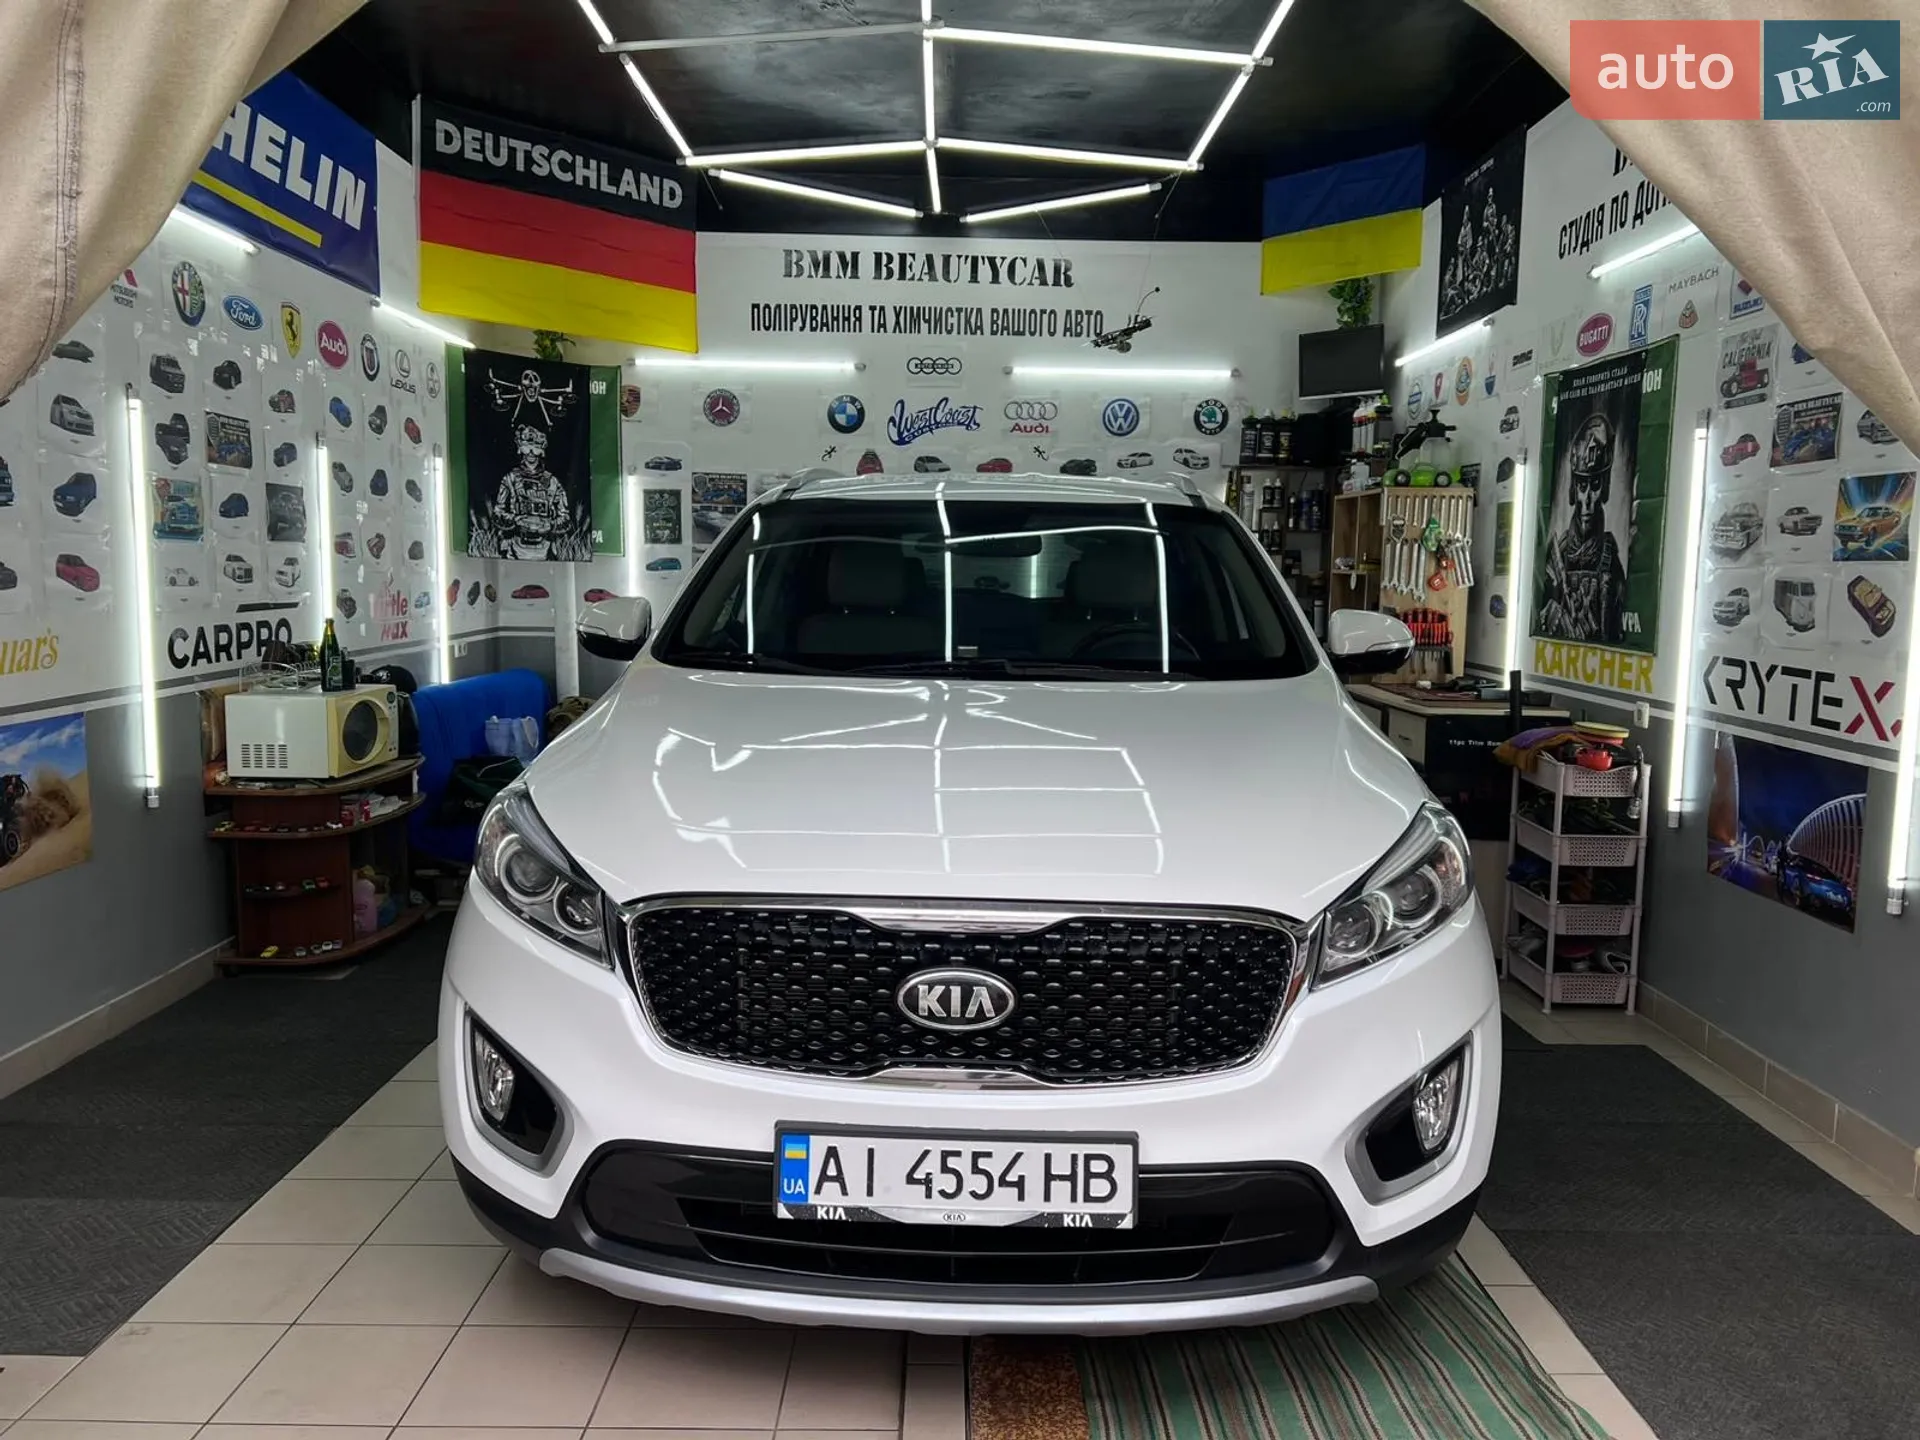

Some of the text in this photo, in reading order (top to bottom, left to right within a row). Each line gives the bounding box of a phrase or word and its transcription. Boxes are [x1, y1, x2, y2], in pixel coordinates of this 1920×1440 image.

[435, 119, 683, 209] DEUTSCHLAND
[1558, 201, 1605, 260] СТУДІЯ
[1609, 190, 1629, 234] ПО
[782, 249, 1075, 288] BMM BEAUTYCAR
[1668, 267, 1719, 294] MAYBACH
[230, 299, 257, 326] Ford
[751, 303, 1104, 338] ПОЛІРУВАННЯ ТА ХІМЧИСТКА ВАШОГО АВТО
[320, 332, 347, 356] Audi
[1579, 324, 1609, 347] BUGATTI
[390, 378, 416, 394] LEXUS
[1010, 422, 1050, 433] Audi
[168, 617, 293, 669] CARPRO
[1534, 640, 1655, 694] KARCHER
[916, 985, 996, 1018] KIA
[783, 1178, 806, 1195] UA
[905, 1148, 1026, 1203] 4554
[1043, 1152, 1119, 1205] HB
[817, 1205, 847, 1220] KIA
[1063, 1213, 1093, 1228] KIA
